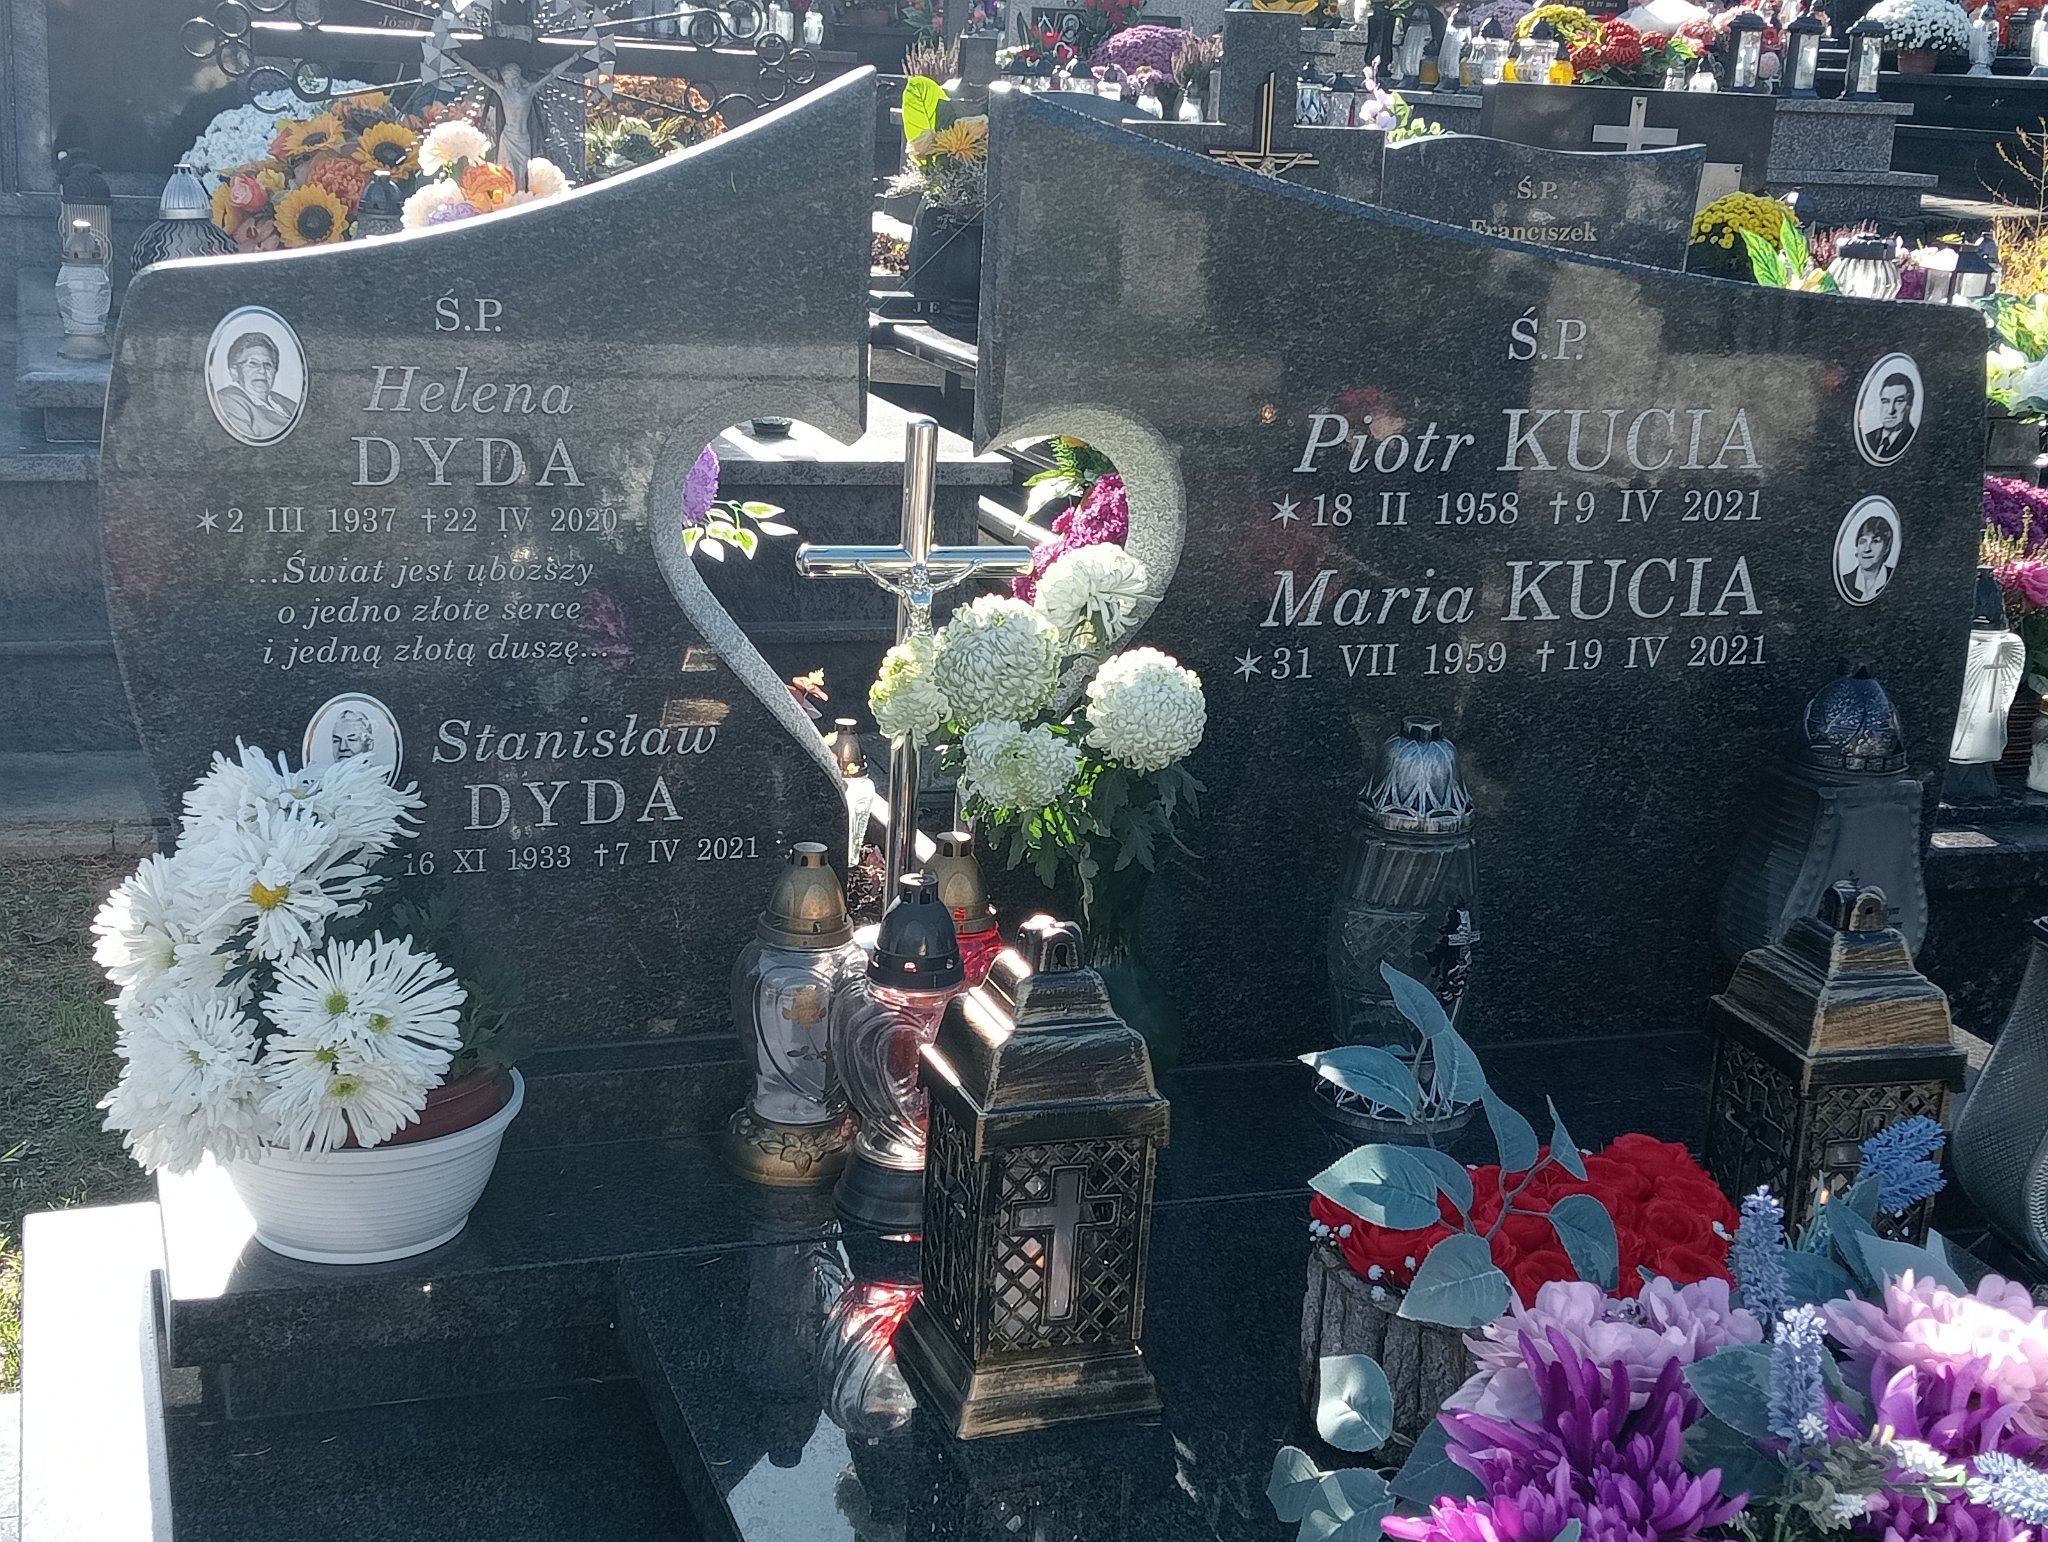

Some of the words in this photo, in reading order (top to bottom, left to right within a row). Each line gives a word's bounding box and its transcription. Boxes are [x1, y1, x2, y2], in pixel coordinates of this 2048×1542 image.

[1470, 219, 1598, 242] Franciszek
[362, 365, 575, 415] Helena
[1293, 413, 1475, 474] Piotr
[1497, 407, 1763, 472] KUCIA
[351, 437, 585, 487] DYDA
[265, 506, 305, 533] III
[328, 507, 397, 533] 1937
[497, 506, 532, 533] IV
[550, 507, 618, 533] 2020
[1376, 492, 1409, 526] II
[1434, 492, 1519, 526] 1958
[1618, 489, 1660, 523] IV
[1681, 489, 1763, 523] 2021
[391, 557, 455, 588] jest
[1259, 567, 1475, 628] Maria
[1500, 555, 1763, 622] KUCIA
[278, 604, 296, 624] o
[302, 596, 401, 629] jedno
[412, 596, 490, 622] złote
[501, 600, 581, 621] serce
[262, 638, 275, 665] i
[281, 635, 382, 670] jedną
[393, 635, 477, 668] złotą
[1339, 644, 1400, 677] VII
[1423, 641, 1507, 675] 1959
[1624, 636, 1669, 669] IV
[1687, 635, 1767, 668] 2021
[431, 714, 719, 764] Stanisław
[463, 775, 684, 831] DYDA
[452, 848, 487, 874] XI
[507, 845, 571, 871] 1933
[647, 838, 681, 863] IV
[697, 836, 759, 861] 2021
